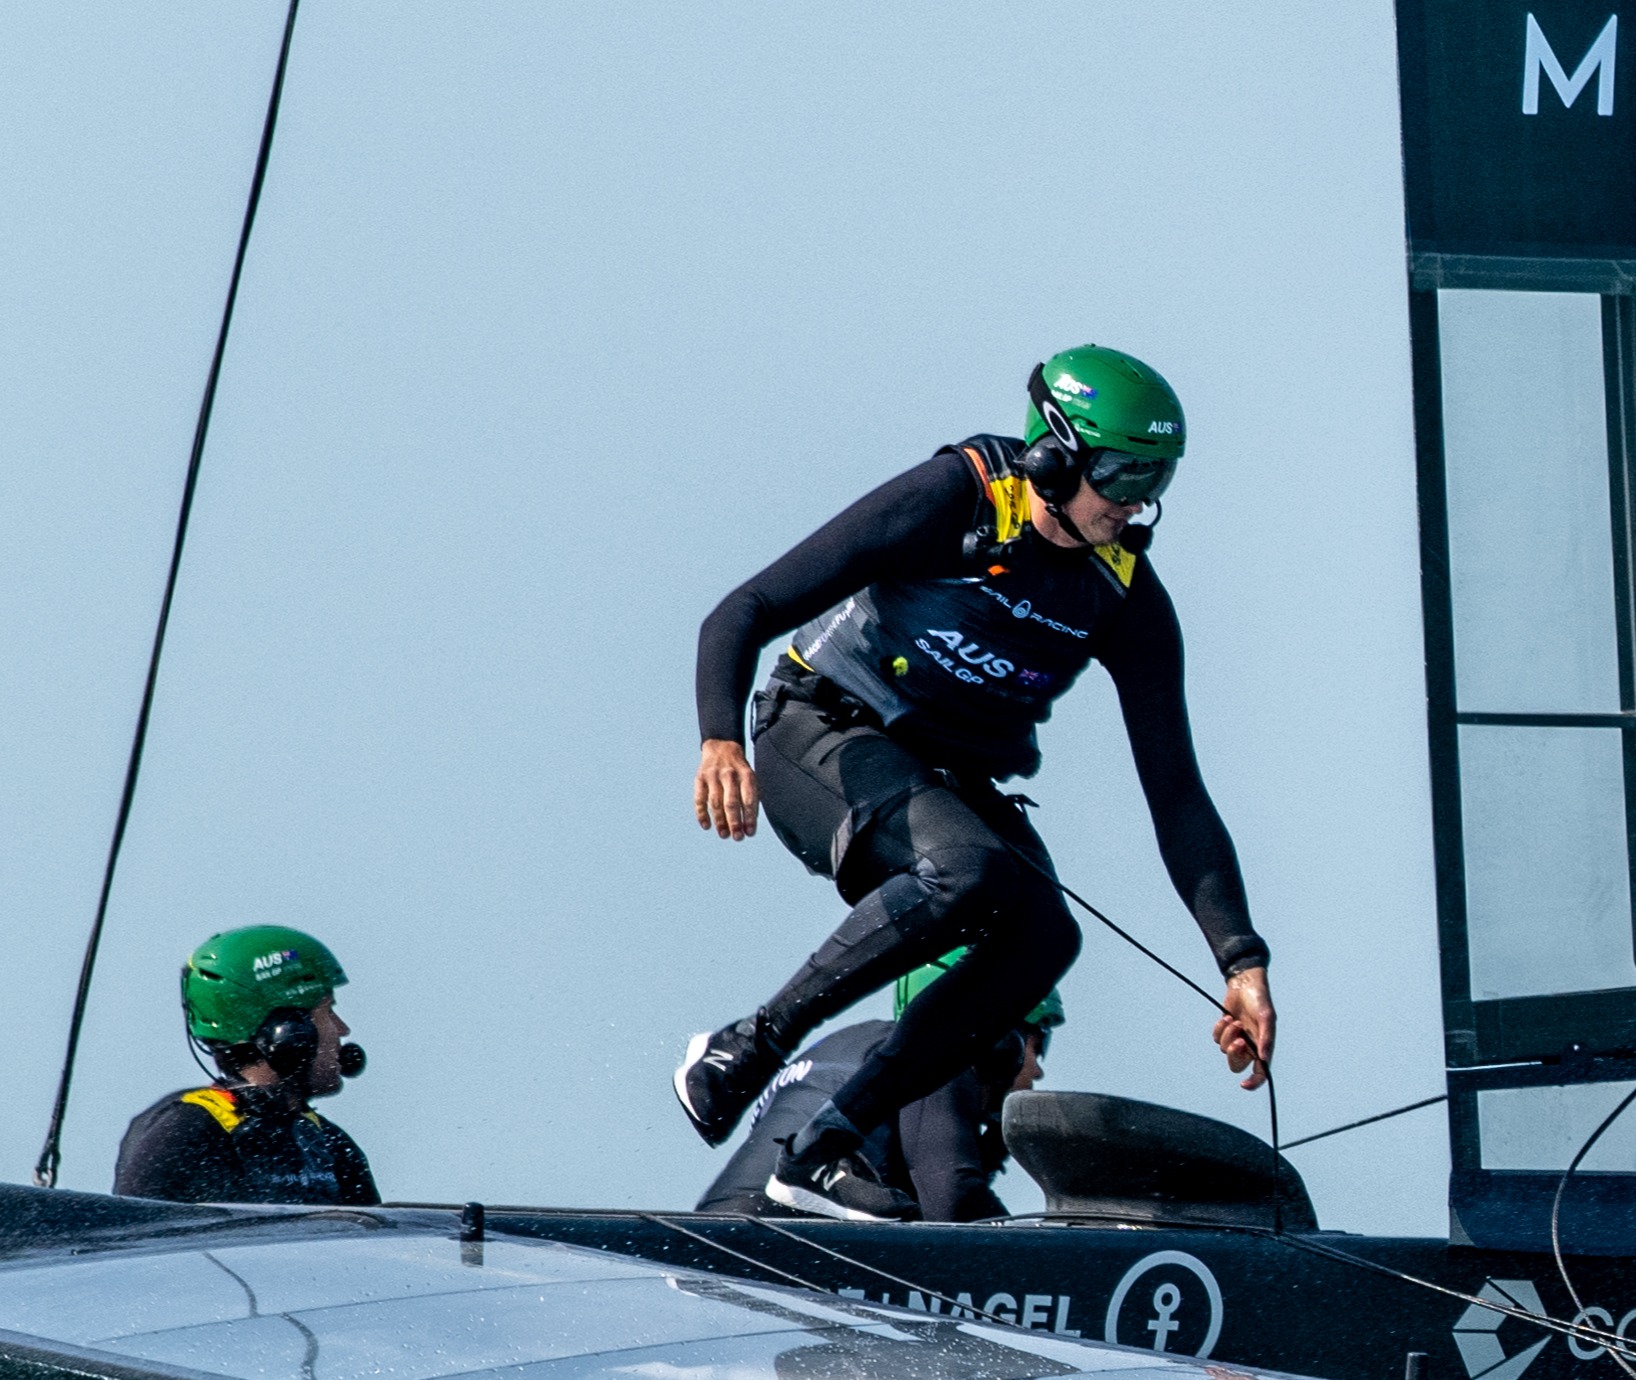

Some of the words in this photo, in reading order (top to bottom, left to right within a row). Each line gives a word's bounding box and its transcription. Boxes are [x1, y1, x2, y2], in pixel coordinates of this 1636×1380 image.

[1147, 420, 1173, 434] AUS
[927, 628, 1015, 678] AUS
[253, 951, 283, 973] AUS
